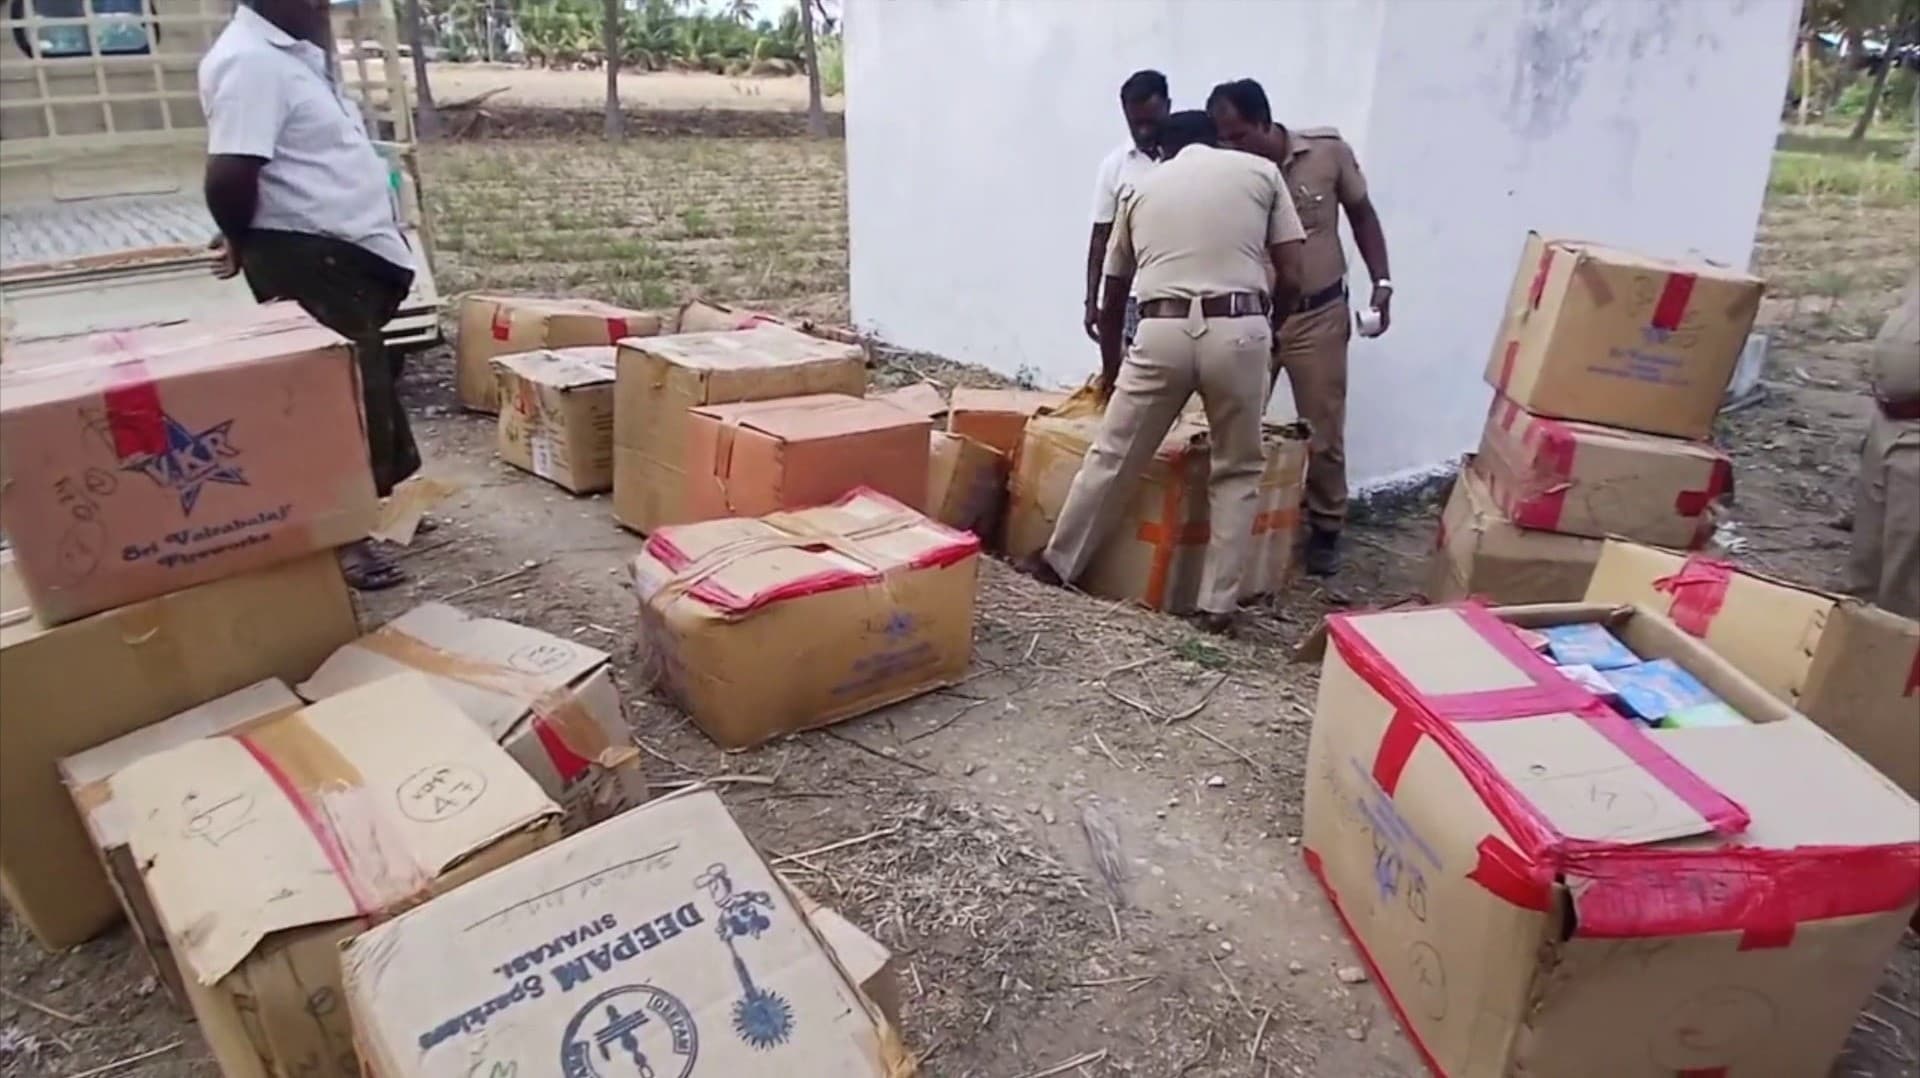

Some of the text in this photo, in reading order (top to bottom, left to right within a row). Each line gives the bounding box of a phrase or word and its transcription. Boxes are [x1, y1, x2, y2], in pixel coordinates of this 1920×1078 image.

[121, 542, 160, 562] Sri
[155, 532, 273, 568] Fireworks
[551, 901, 705, 993] DEEPAM
